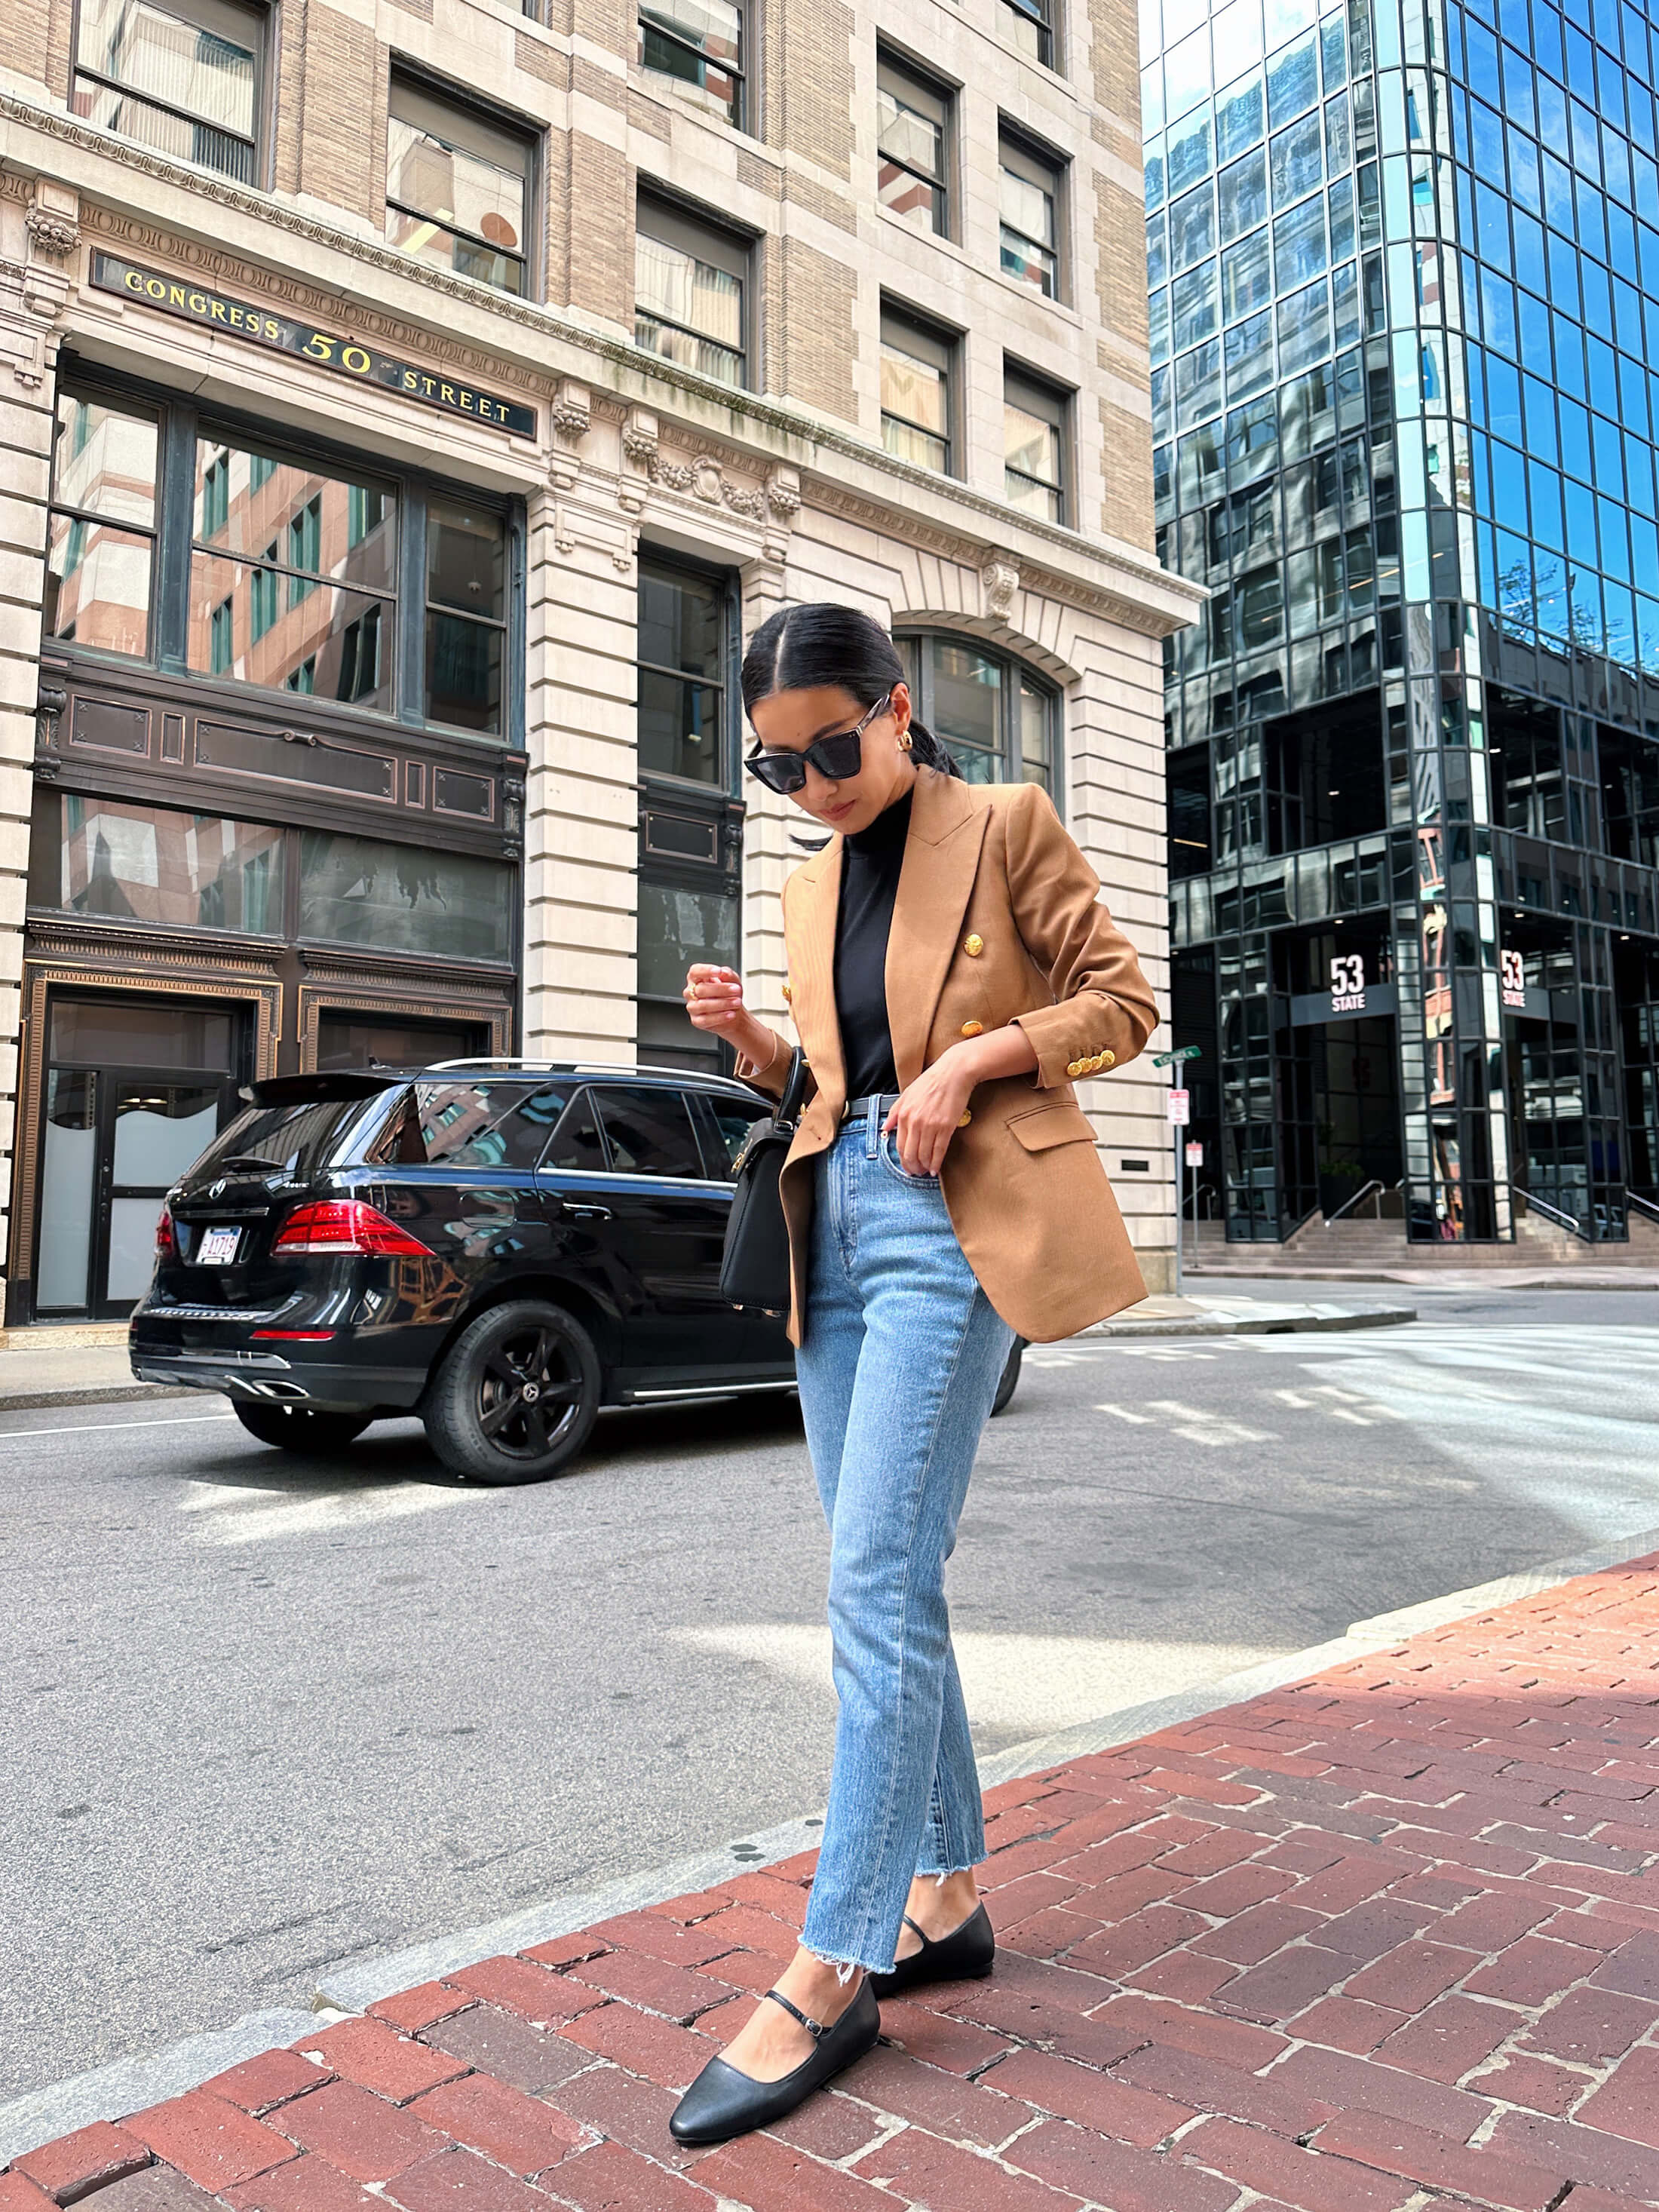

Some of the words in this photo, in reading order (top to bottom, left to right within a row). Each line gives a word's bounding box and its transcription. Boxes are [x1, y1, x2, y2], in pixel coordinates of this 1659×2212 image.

[125, 272, 279, 339] CONGRESS
[302, 333, 371, 373] 50
[403, 371, 510, 422] STREET
[1330, 954, 1364, 996] 53
[1501, 950, 1524, 990] 53
[1332, 993, 1366, 1011] STATE
